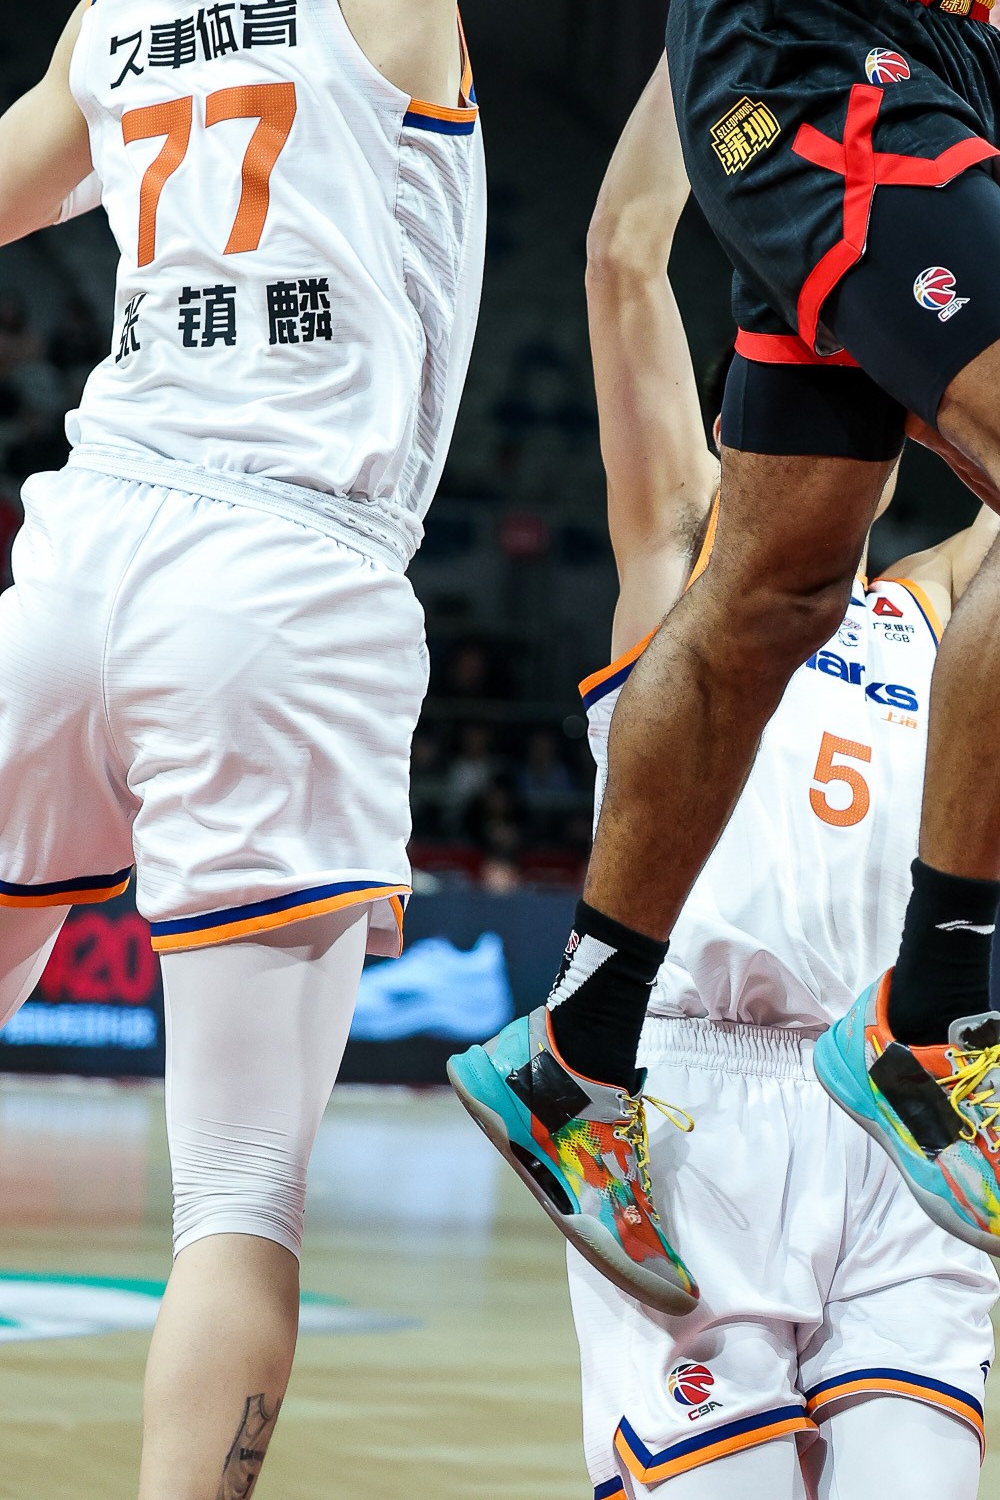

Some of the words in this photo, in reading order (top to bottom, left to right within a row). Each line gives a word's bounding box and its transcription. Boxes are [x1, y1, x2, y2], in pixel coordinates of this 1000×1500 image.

[718, 107, 777, 167] 深圳
[121, 81, 298, 268] 77
[939, 297, 971, 322] CBA
[884, 632, 910, 643] CGB
[809, 731, 872, 827] 5
[688, 1401, 723, 1421] CBA
